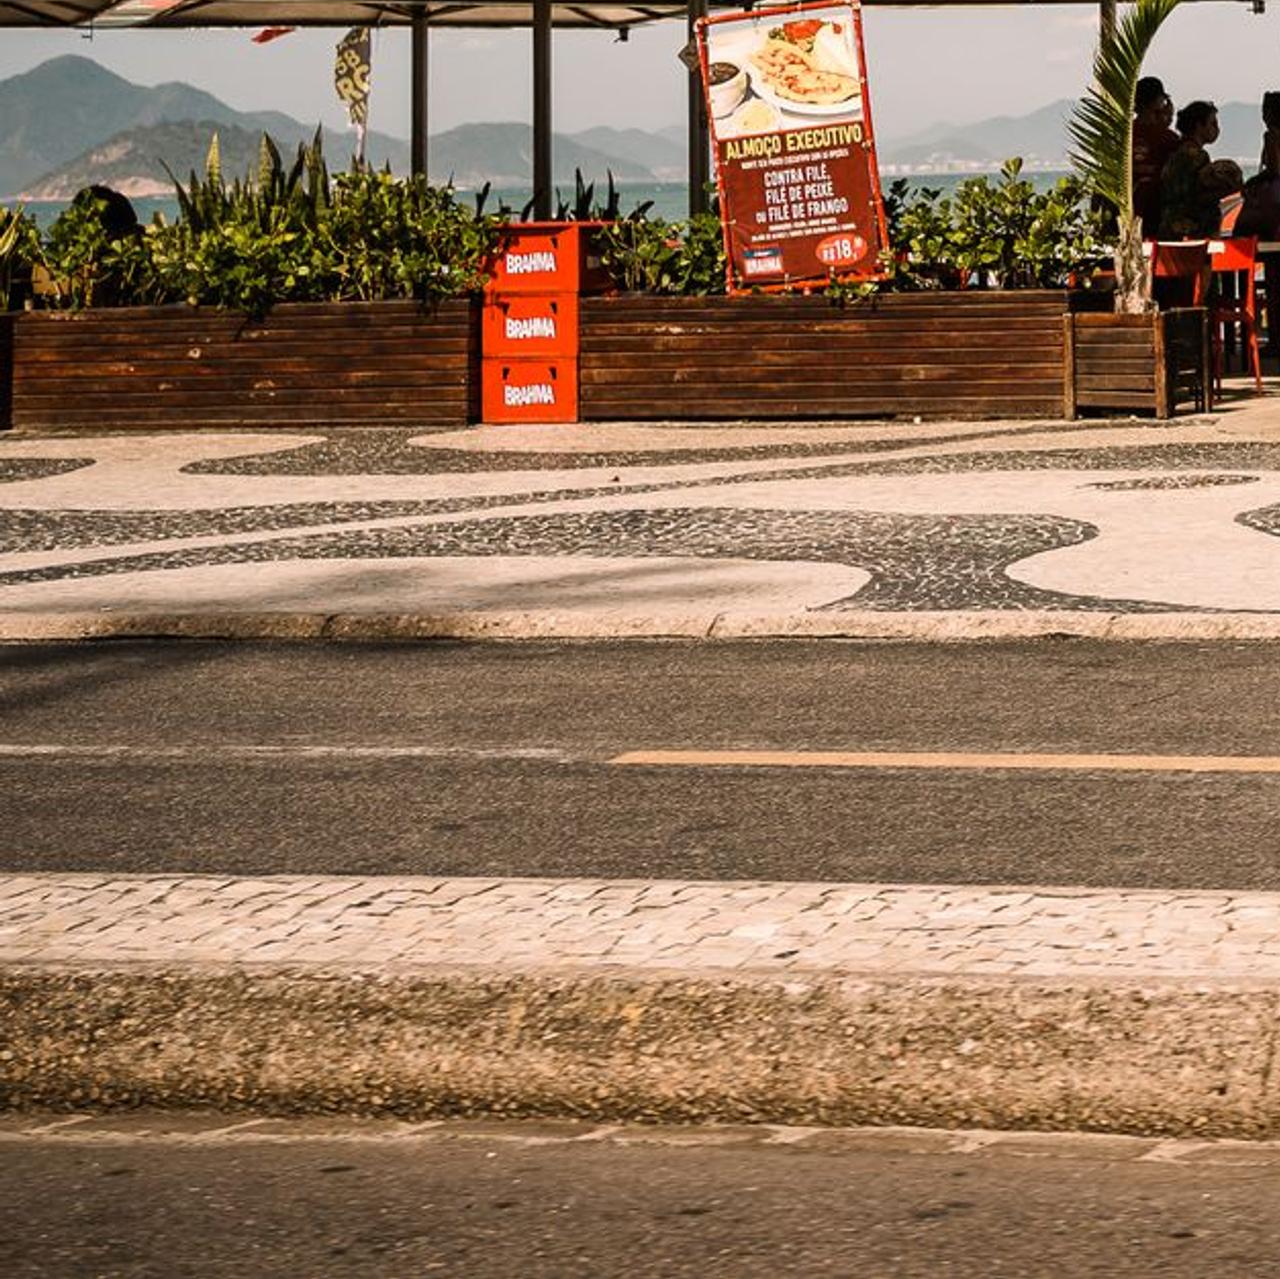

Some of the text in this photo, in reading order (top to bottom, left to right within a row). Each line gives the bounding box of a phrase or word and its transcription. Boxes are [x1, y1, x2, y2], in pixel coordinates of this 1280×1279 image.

[726, 135, 782, 160] ALMOÇO
[786, 124, 863, 152] EXECUTIVO
[763, 167, 805, 188] CONTRA
[788, 184, 803, 202] DE
[804, 181, 835, 200] PEIXE
[791, 202, 806, 220] DE
[807, 198, 850, 218] FRANGO
[505, 251, 557, 275] BRAHMA
[505, 317, 556, 340] BRAHMA
[504, 384, 555, 406] BRAHMA
